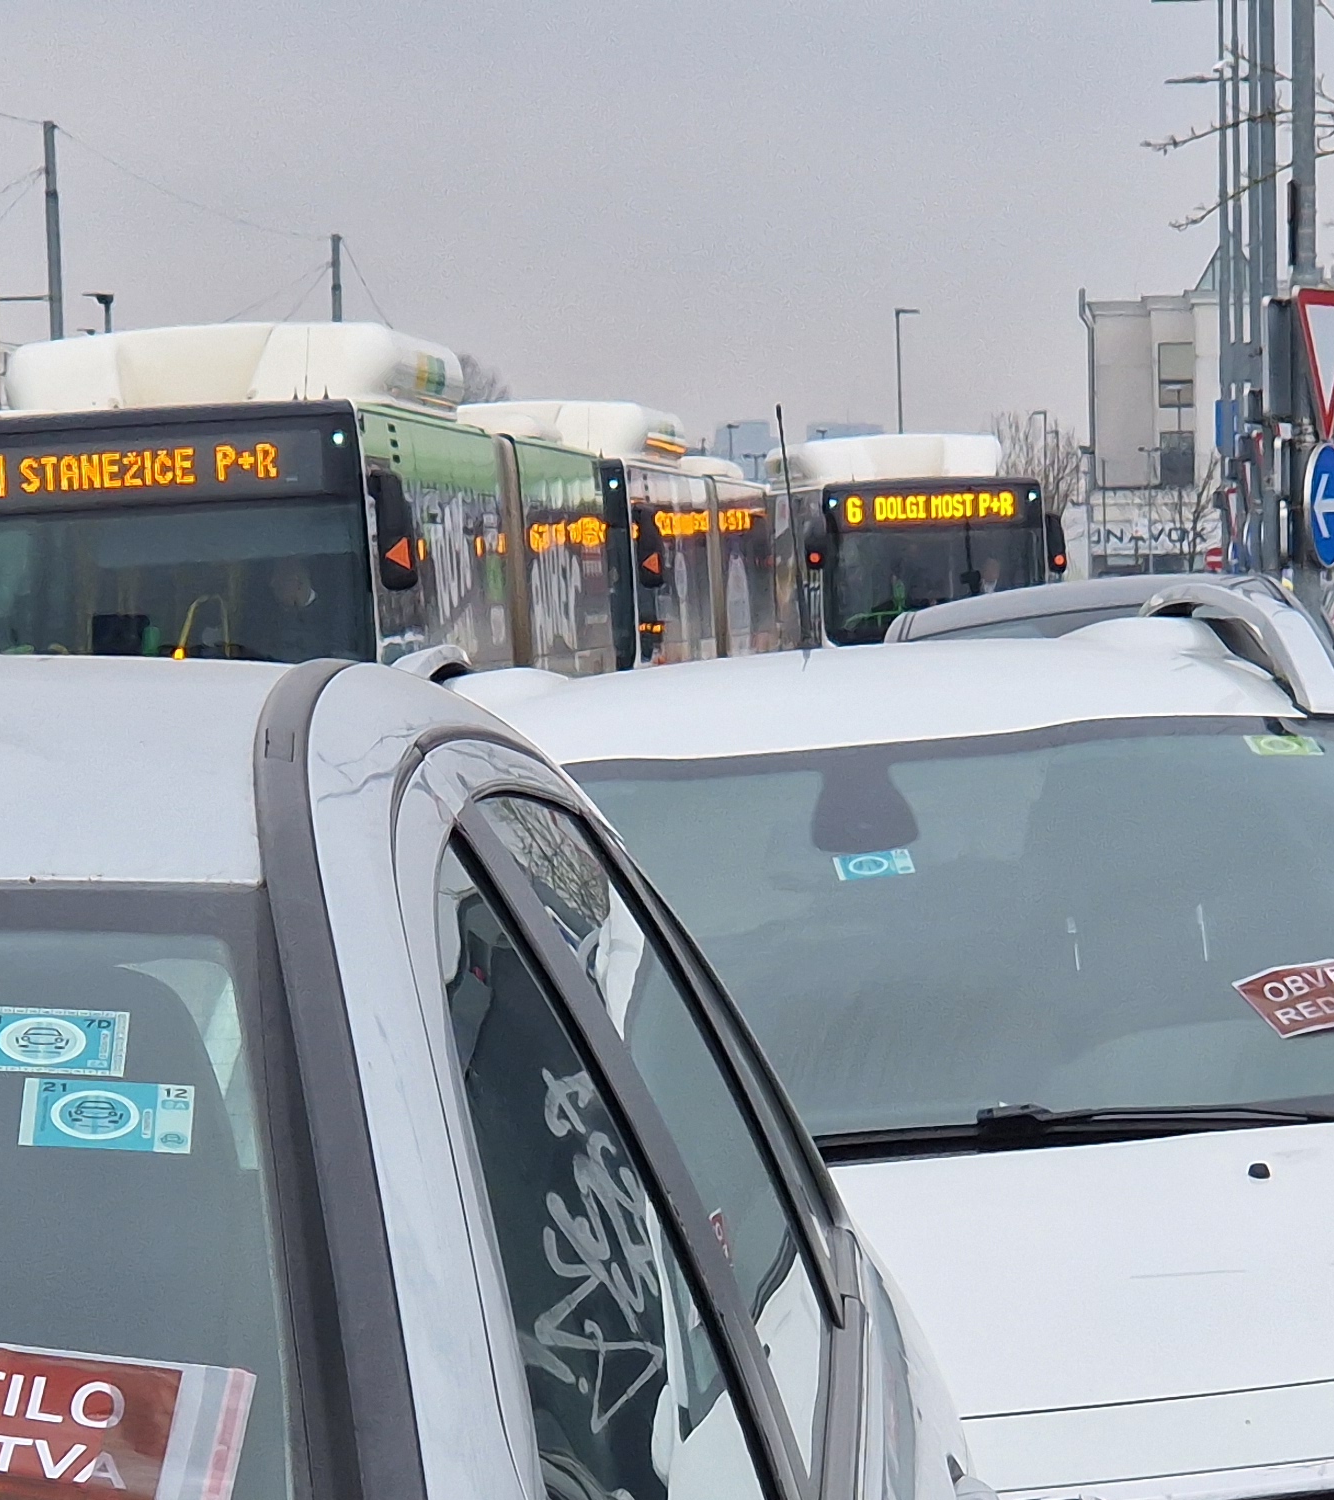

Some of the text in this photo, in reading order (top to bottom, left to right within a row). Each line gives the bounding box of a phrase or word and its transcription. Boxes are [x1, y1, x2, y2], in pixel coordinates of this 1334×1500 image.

[215, 443, 278, 481] P+R
[846, 490, 1015, 524] 6 DOLGI MOST P+R
[42, 1081, 188, 1099] 21 12
